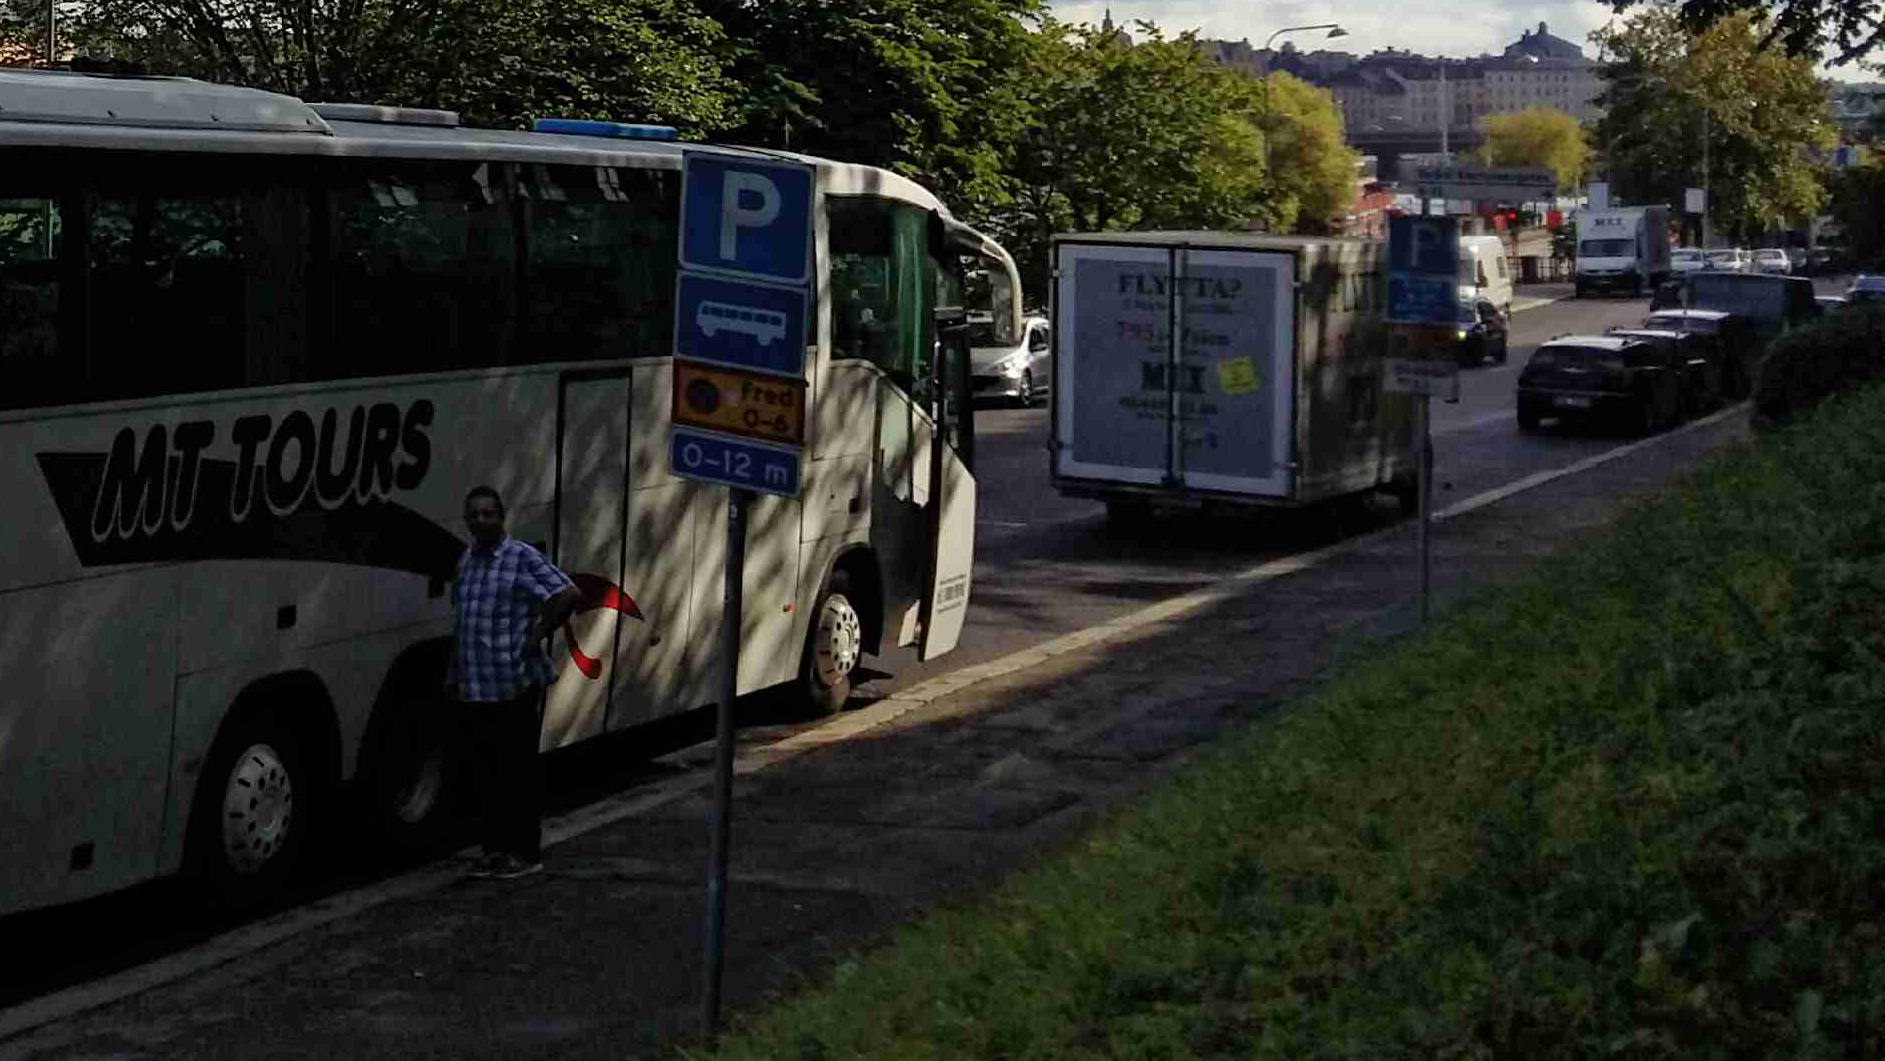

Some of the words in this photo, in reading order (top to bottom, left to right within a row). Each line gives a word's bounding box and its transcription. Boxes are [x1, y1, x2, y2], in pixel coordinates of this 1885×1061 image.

[719, 169, 781, 261] P
[91, 422, 214, 540] MT
[228, 399, 435, 524] TOURS
[681, 441, 754, 478] 0-12
[764, 463, 788, 486] m
